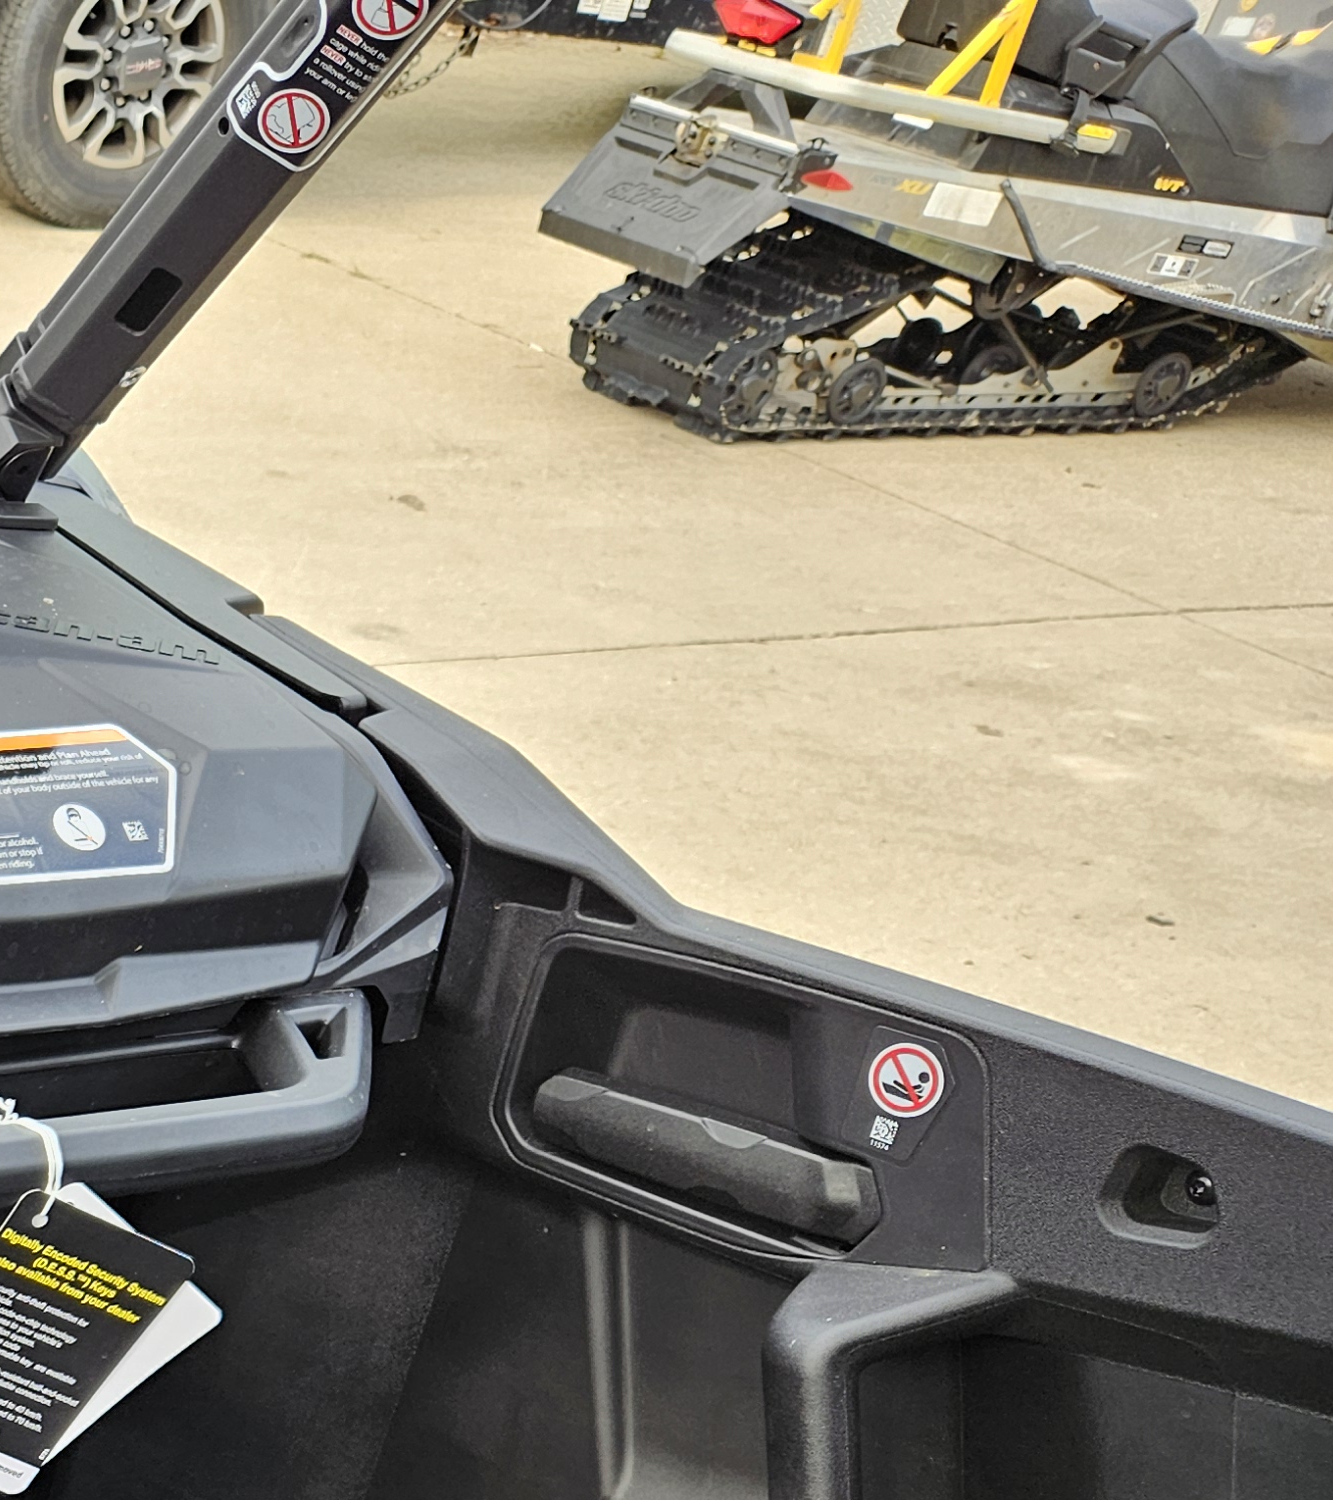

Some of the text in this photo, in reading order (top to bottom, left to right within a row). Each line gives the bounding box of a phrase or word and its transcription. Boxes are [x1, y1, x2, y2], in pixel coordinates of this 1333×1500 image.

[326, 36, 368, 65] cage while
[336, 27, 361, 43] NEVER
[358, 41, 379, 56] hold
[321, 46, 344, 63] NEVER
[6, 837, 39, 847] alcohol.
[7, 849, 17, 857] or
[17, 847, 36, 856] stop
[36, 846, 43, 855] if
[8, 859, 35, 870] riding.
[0, 1227, 168, 1307] Digitally Encoded Security System
[14, 1263, 61, 1289] available
[57, 1282, 85, 1301] from
[81, 1292, 109, 1311] your
[105, 1302, 140, 1325] dealer
[87, 1279, 118, 1300] Keys
